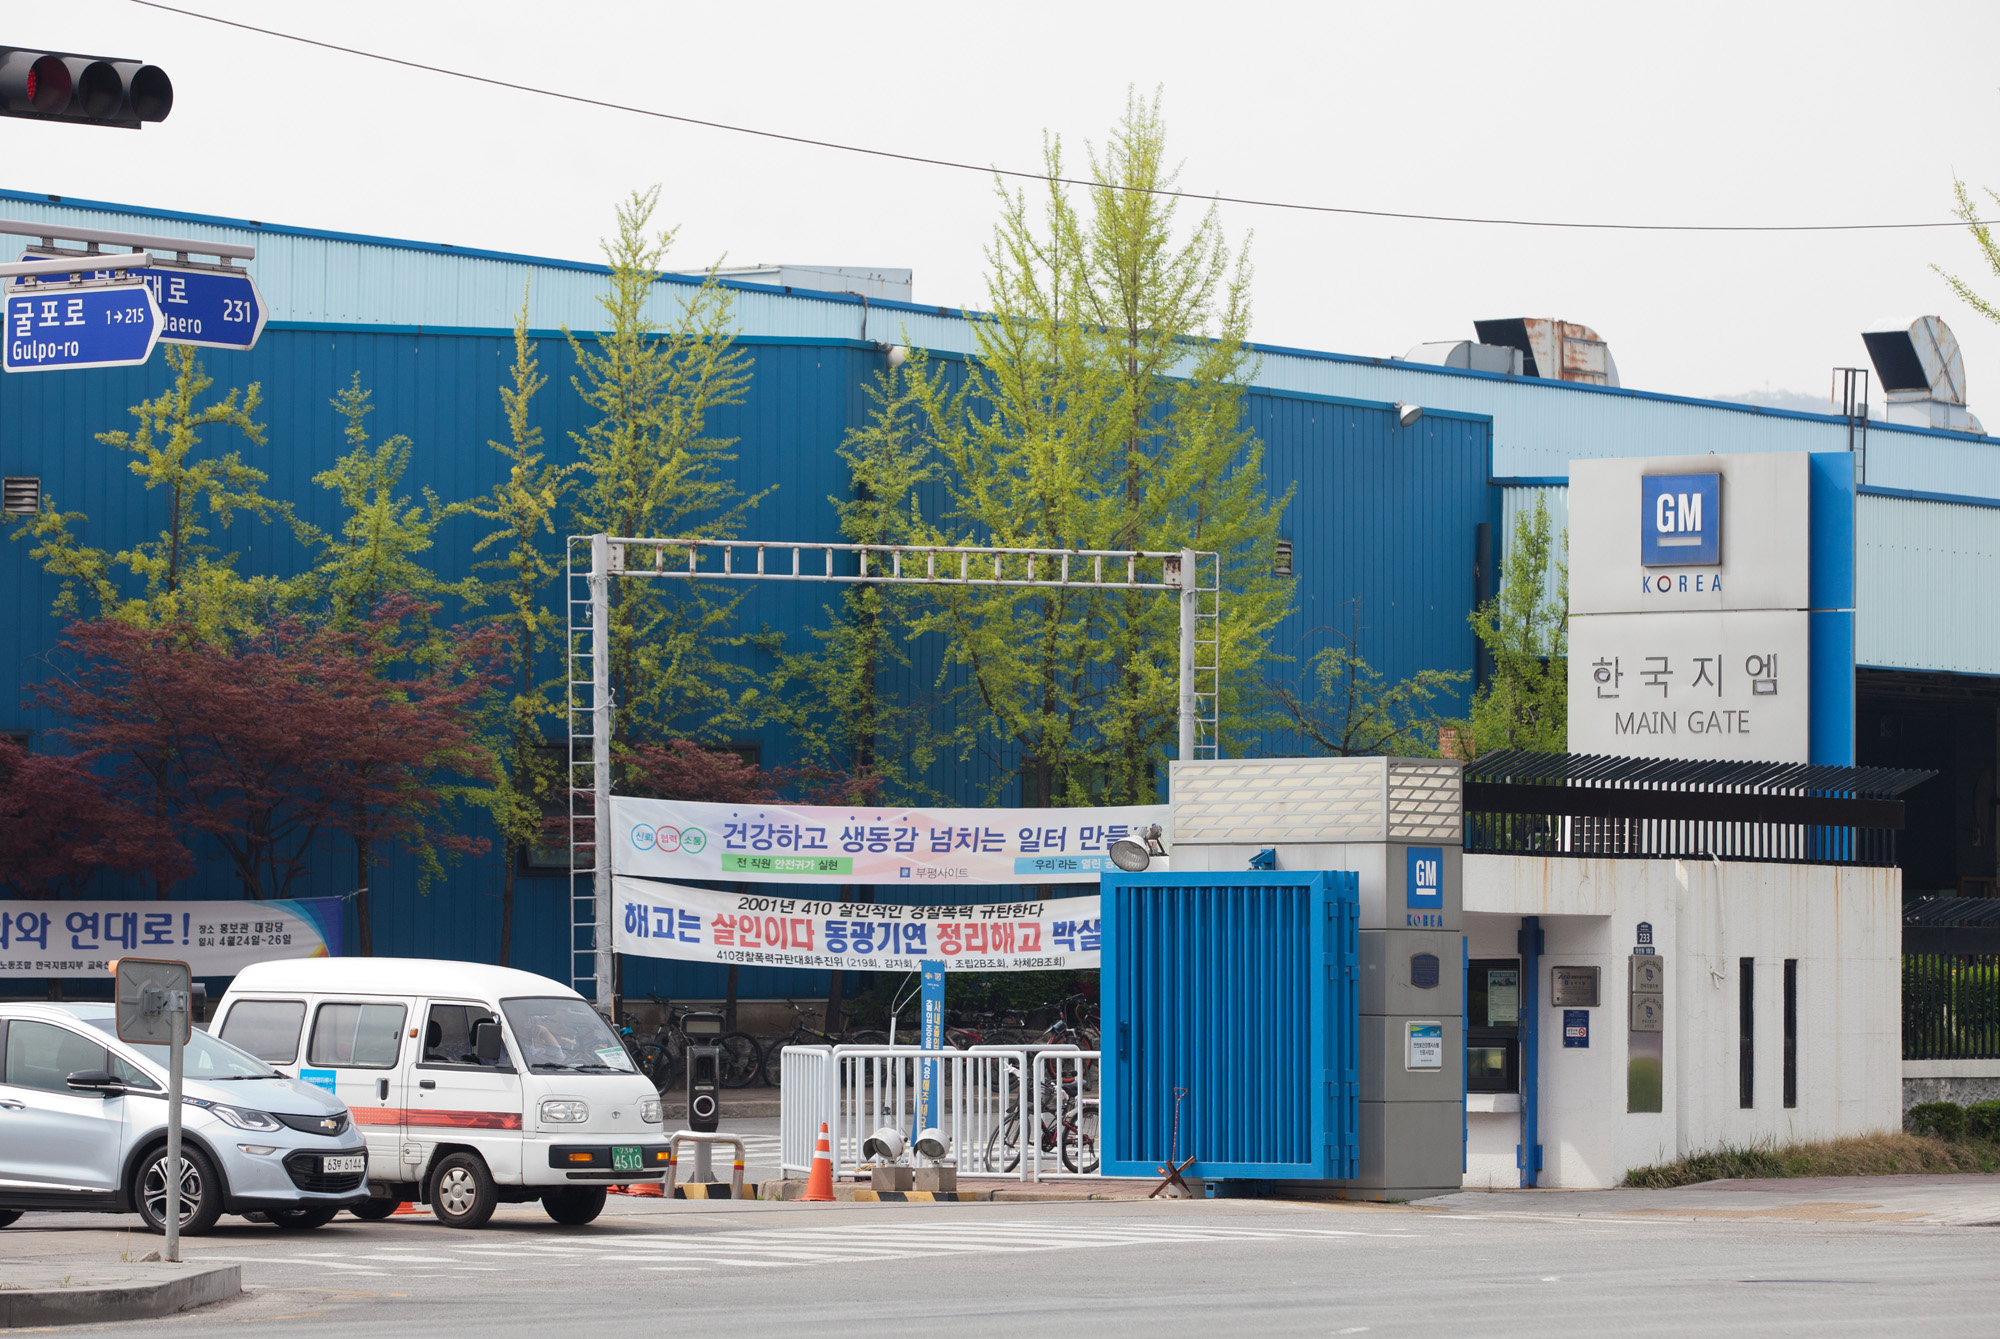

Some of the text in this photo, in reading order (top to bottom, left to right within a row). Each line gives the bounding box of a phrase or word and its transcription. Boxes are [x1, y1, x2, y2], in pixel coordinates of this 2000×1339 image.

[13, 298, 86, 337] 굴포로
[125, 307, 144, 324] 215
[223, 299, 250, 323] 231
[13, 340, 79, 362] Gulpo-ro
[1656, 493, 1702, 533] GM
[1642, 574, 1722, 593] KOREA
[1592, 653, 1778, 699] 한국지엠
[1615, 710, 1750, 735] MAIN GATE
[635, 831, 654, 843] 신뢰
[683, 835, 702, 846] 소통
[723, 822, 828, 851] 건강하고
[840, 826, 919, 853] 생동감
[929, 827, 1006, 853] 넘치는
[1019, 826, 1067, 853] 일터
[737, 857, 838, 871] 전 직원 안전귀가 실현
[1081, 858, 1101, 869] 열린
[916, 867, 969, 879] 부평사이트
[1415, 859, 1437, 887] GM
[737, 896, 1044, 920] 2001년 410 살인적인 경찰폭력 규탄한다
[198, 921, 284, 935] 장소 홍보관 대강당
[624, 902, 701, 944] 해고는
[710, 912, 815, 952] 살인이다
[825, 919, 928, 955] 동광기연
[936, 921, 1042, 956] 정리해고
[1407, 913, 1443, 928] KOREA
[65, 911, 191, 950] 연대로!
[1639, 933, 1650, 943] 233
[198, 937, 215, 947] 일시
[35, 960, 84, 970] 한국지엠지부
[344, 1158, 361, 1170] 6144
[614, 1154, 642, 1169] 4510
